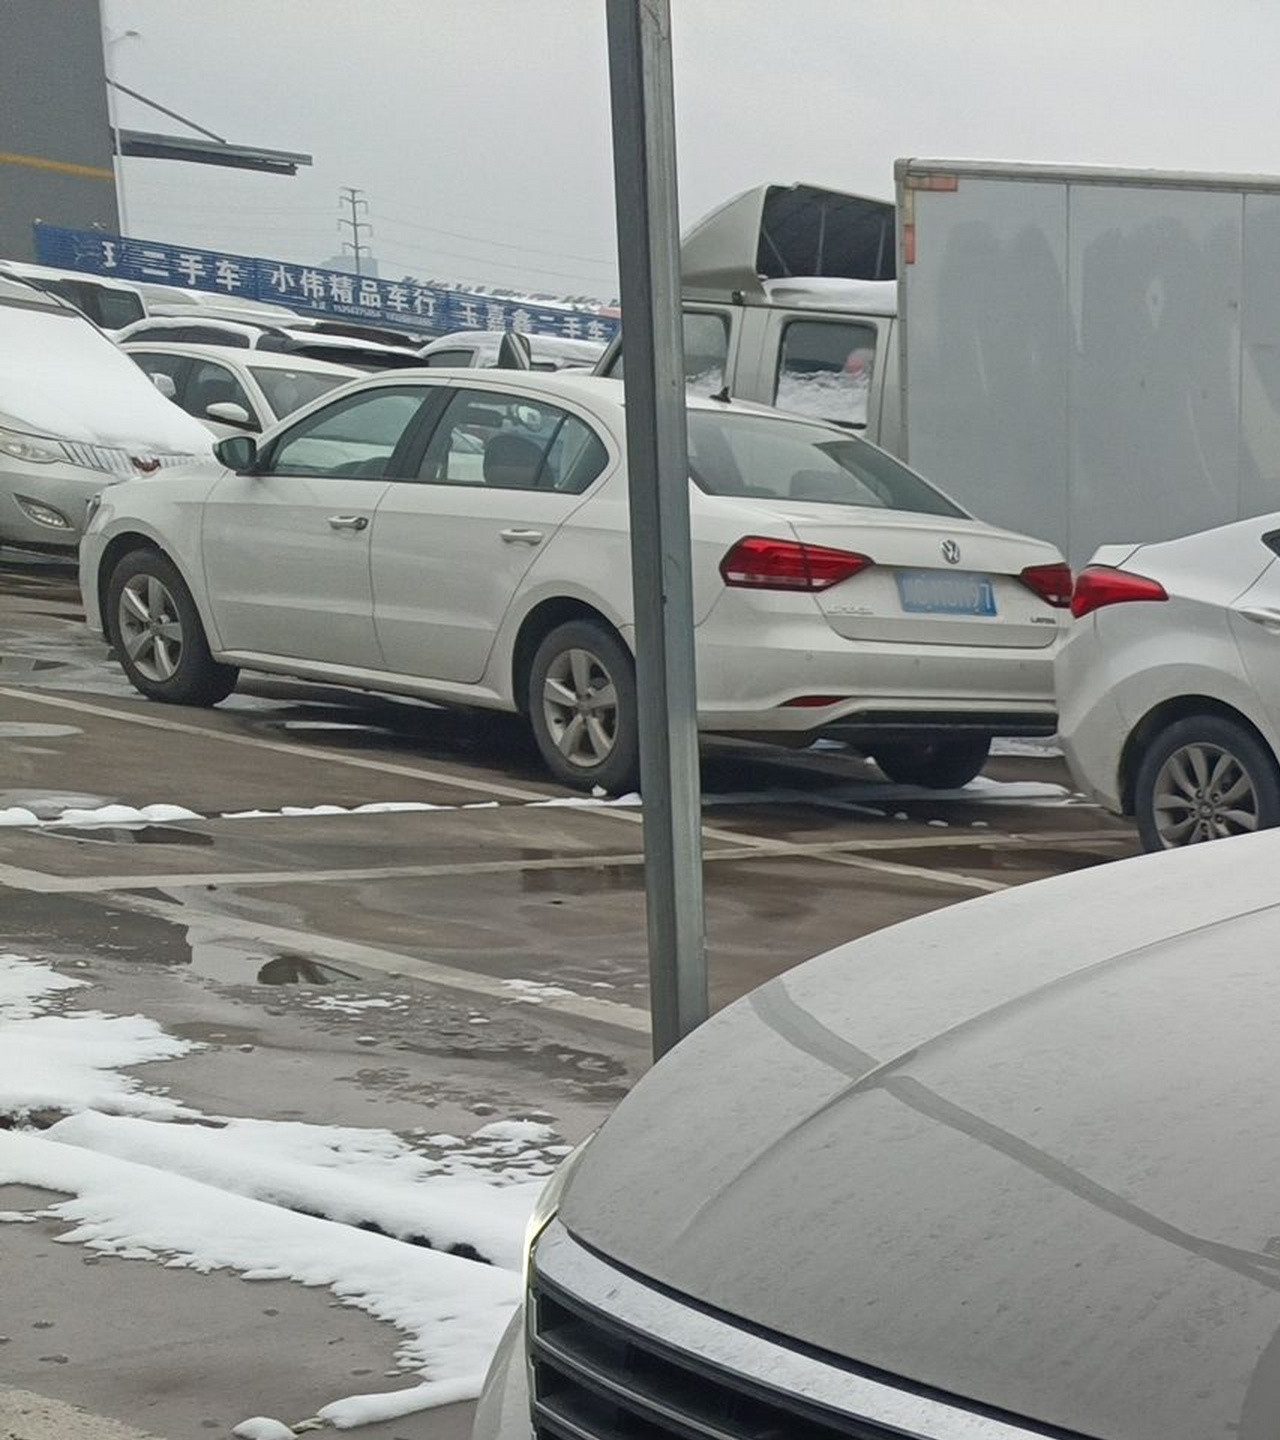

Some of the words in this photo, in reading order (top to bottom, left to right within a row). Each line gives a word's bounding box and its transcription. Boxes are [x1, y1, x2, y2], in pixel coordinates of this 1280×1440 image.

[270, 265, 437, 317] 小伟精品车行
